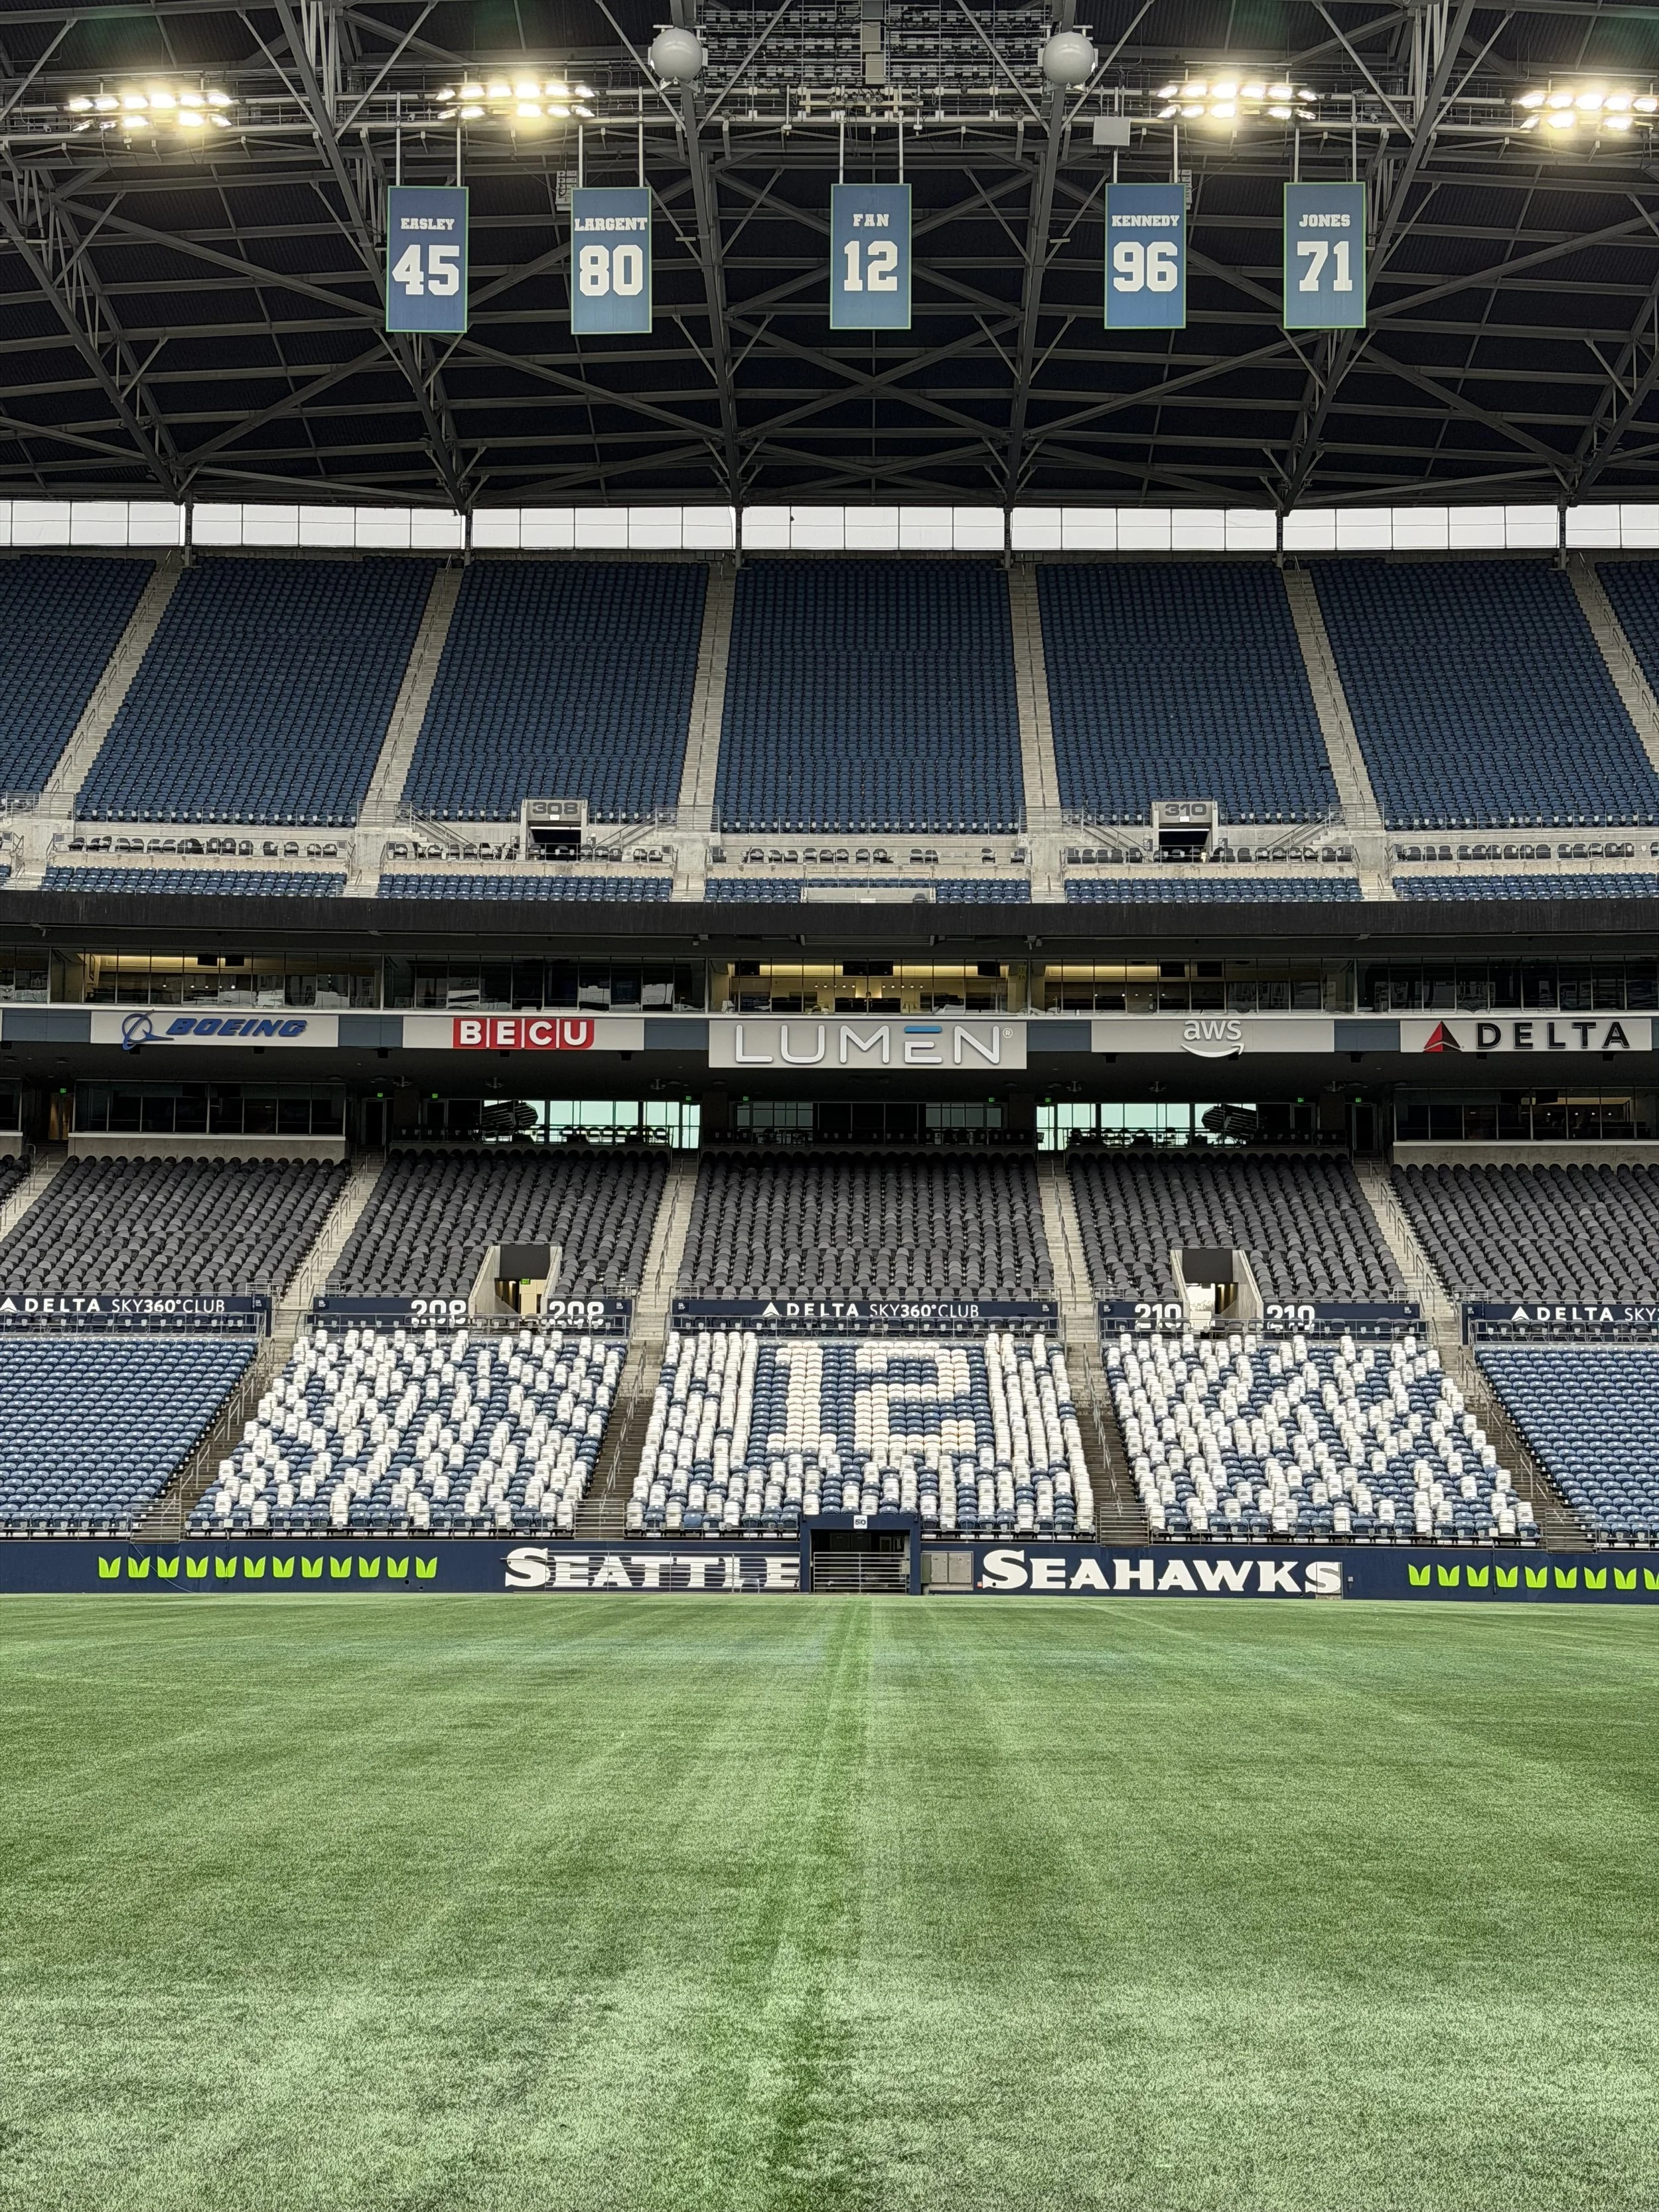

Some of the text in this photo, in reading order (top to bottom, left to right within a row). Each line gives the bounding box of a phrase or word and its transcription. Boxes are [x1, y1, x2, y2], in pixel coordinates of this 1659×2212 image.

[401, 218, 455, 230] EASLEY
[574, 217, 648, 232] LARGENT
[853, 214, 889, 227] FAN
[1112, 215, 1180, 227] KENNEDY
[1299, 214, 1350, 227] JONES
[392, 244, 460, 296] 45
[579, 244, 643, 297] 80
[844, 240, 898, 291] 12
[1113, 241, 1178, 292] 96
[1297, 241, 1353, 292] 71
[532, 802, 578, 814] 308
[1165, 803, 1207, 816] 310
[166, 1017, 308, 1037] BOEING
[459, 1020, 588, 1046] BECU
[1183, 1020, 1242, 1040] aws
[1476, 1021, 1630, 1049] DELTA
[25, 1297, 100, 1312] DELTA
[411, 1299, 467, 1325] 208
[549, 1301, 605, 1325] 208
[786, 1303, 859, 1317] DELTA
[1135, 1303, 1182, 1329] 210
[1537, 1307, 1659, 1321] DELTA SKY
[1267, 1305, 1315, 1330] 210
[767, 1341, 976, 1453] 12
[505, 1547, 800, 1588] SEATTLE
[982, 1550, 1341, 1593] SEAHAWKS
